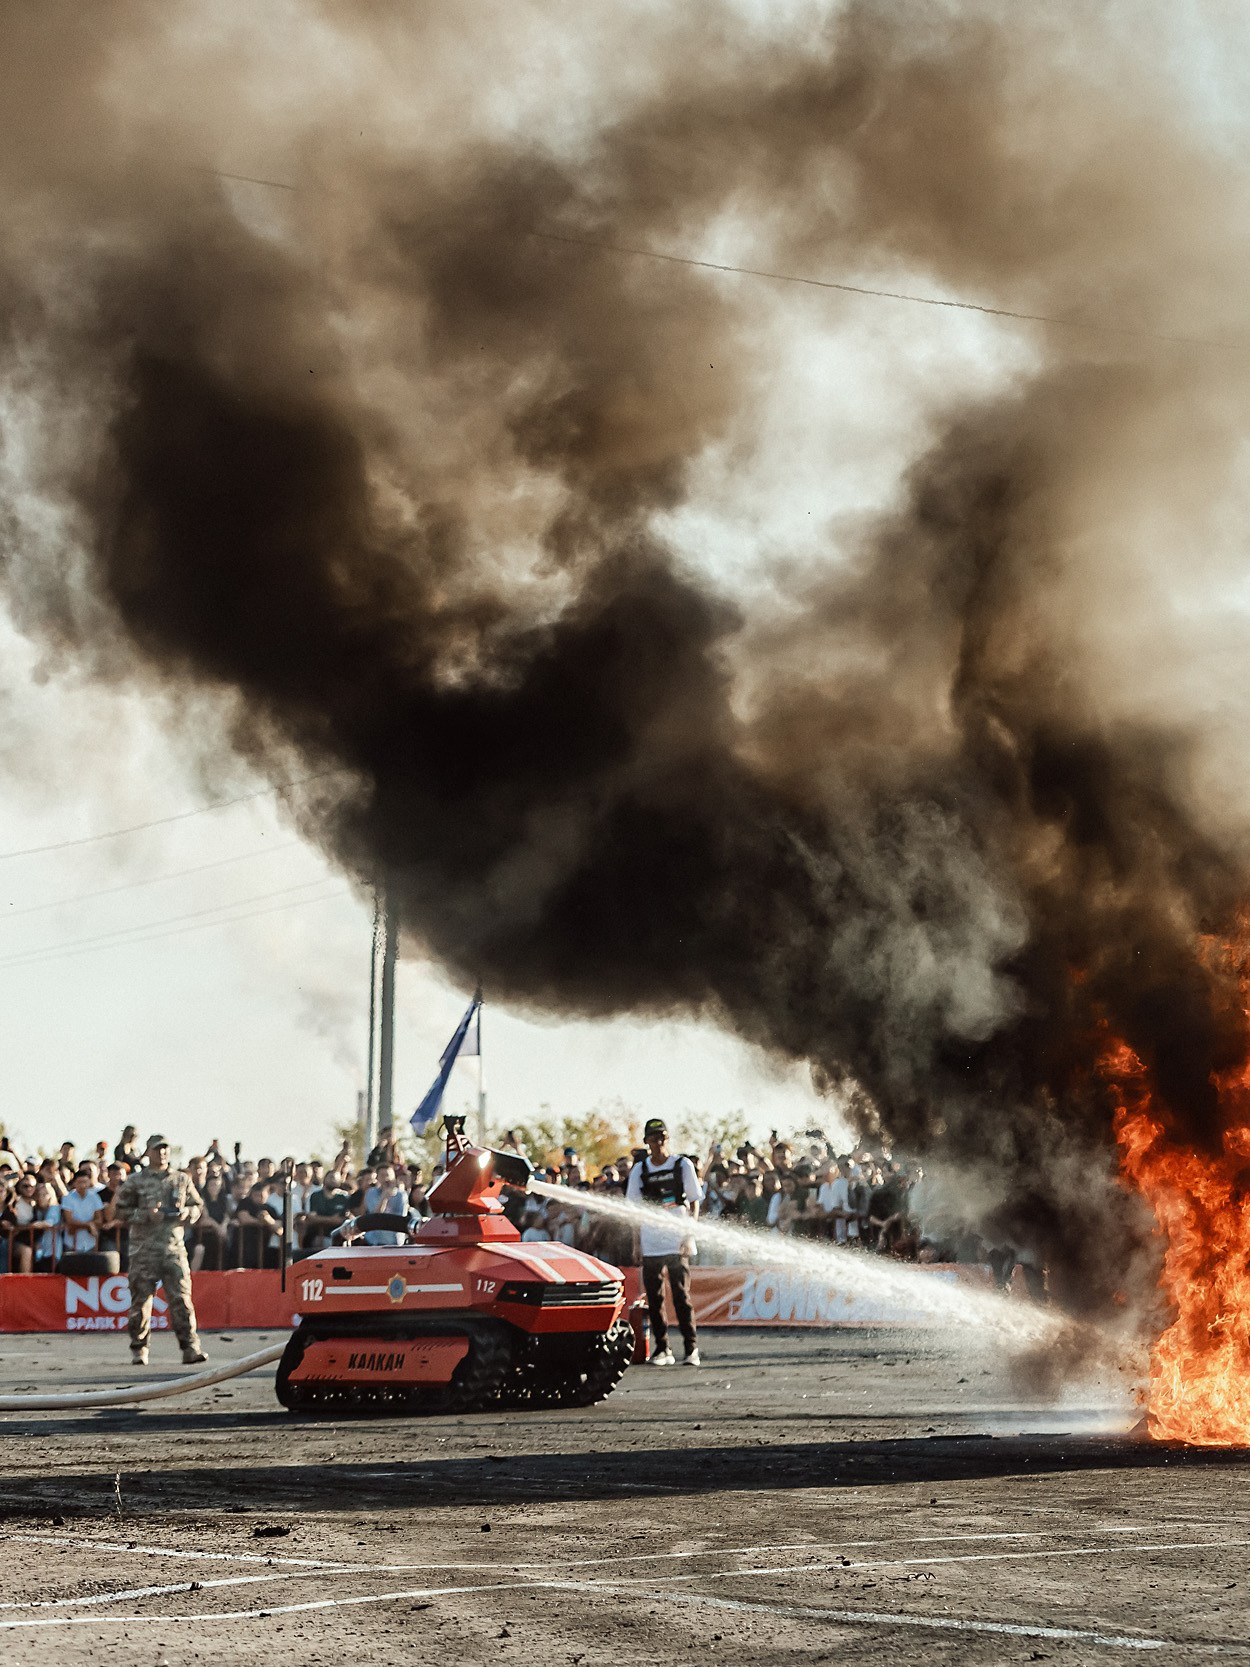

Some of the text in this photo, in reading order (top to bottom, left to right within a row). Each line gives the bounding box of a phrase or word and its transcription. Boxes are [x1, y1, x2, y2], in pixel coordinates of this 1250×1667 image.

[302, 1279, 324, 1301] 112
[476, 1279, 496, 1293] 112
[66, 1315, 116, 1330] SPARK
[348, 1352, 405, 1371] КАЛКАН
